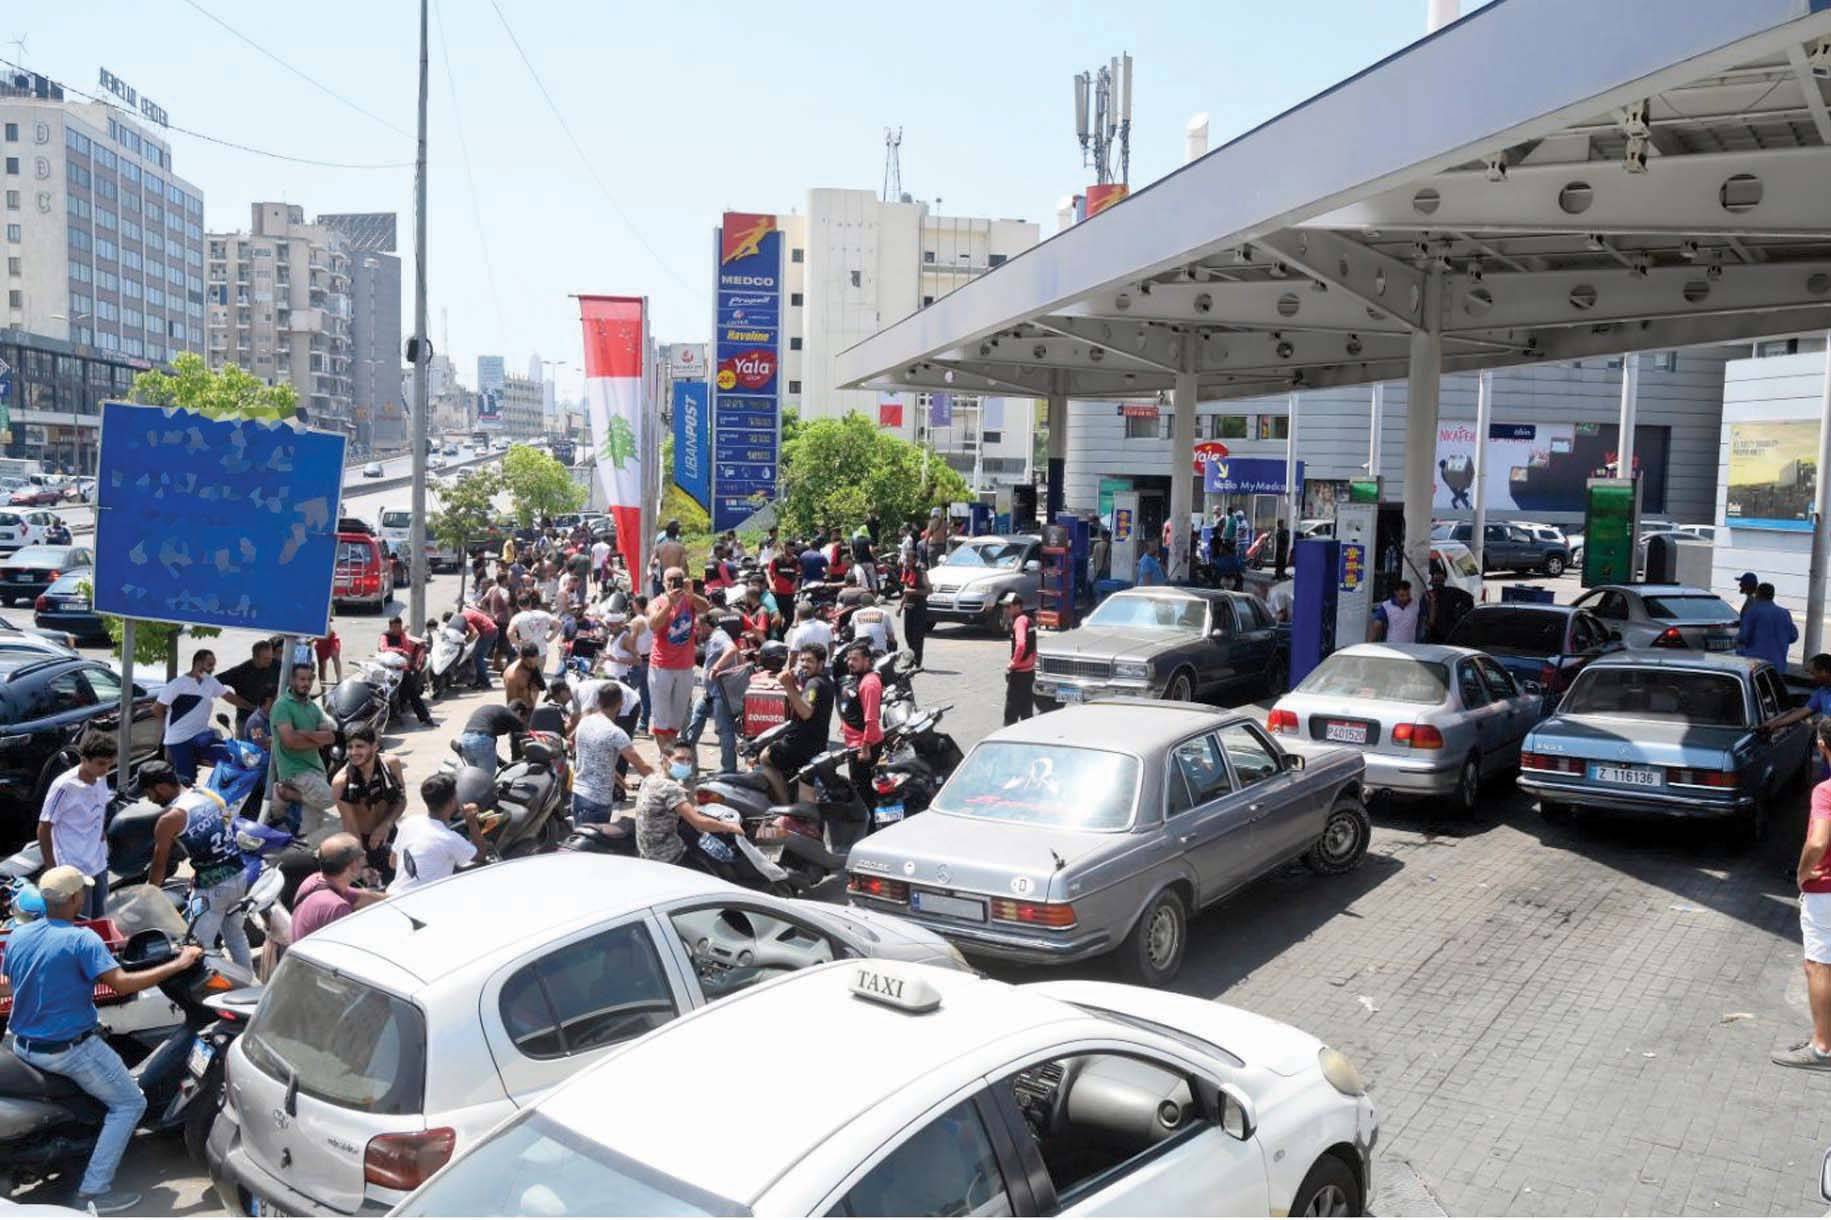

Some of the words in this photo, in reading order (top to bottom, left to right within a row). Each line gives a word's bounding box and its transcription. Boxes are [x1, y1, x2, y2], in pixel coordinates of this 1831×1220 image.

[721, 275, 774, 286] MEDCO
[735, 358, 769, 374] Yala
[684, 394, 698, 480] LIBANPOST
[1599, 768, 1607, 780] Z
[1613, 770, 1654, 784] 116136
[857, 969, 905, 998] TAXI
